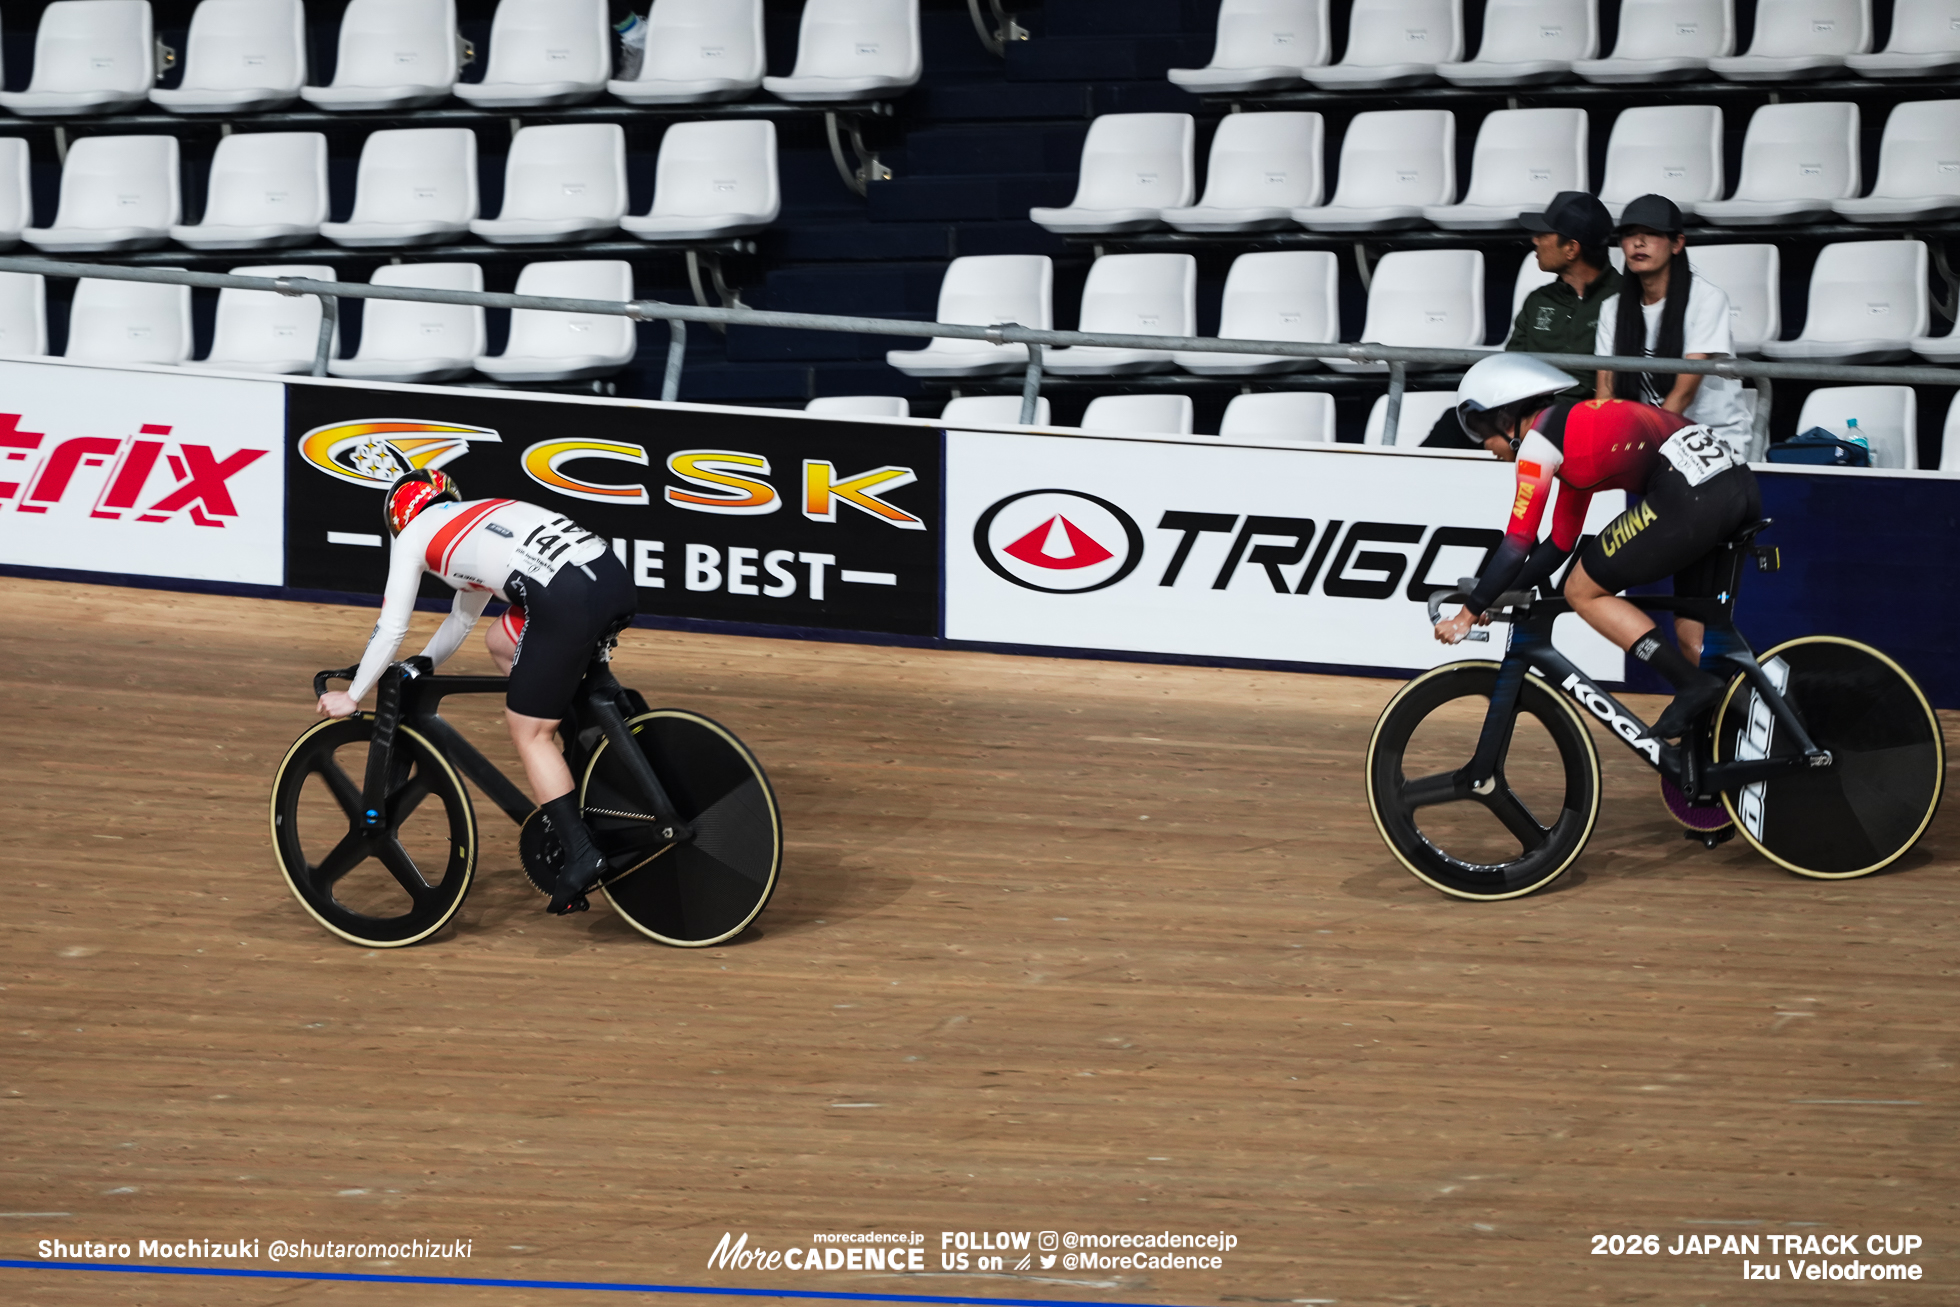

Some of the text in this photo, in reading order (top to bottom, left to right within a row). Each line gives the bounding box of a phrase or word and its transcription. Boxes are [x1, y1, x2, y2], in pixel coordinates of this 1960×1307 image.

[1681, 431, 1725, 468] 132
[403, 486, 432, 525] JAPAN
[521, 437, 927, 531] CSK
[1512, 481, 1536, 520] ANTA
[522, 524, 572, 563] 141
[1601, 499, 1658, 558] CHINA
[684, 543, 836, 600] BEST
[1561, 672, 1661, 766] KOGA
